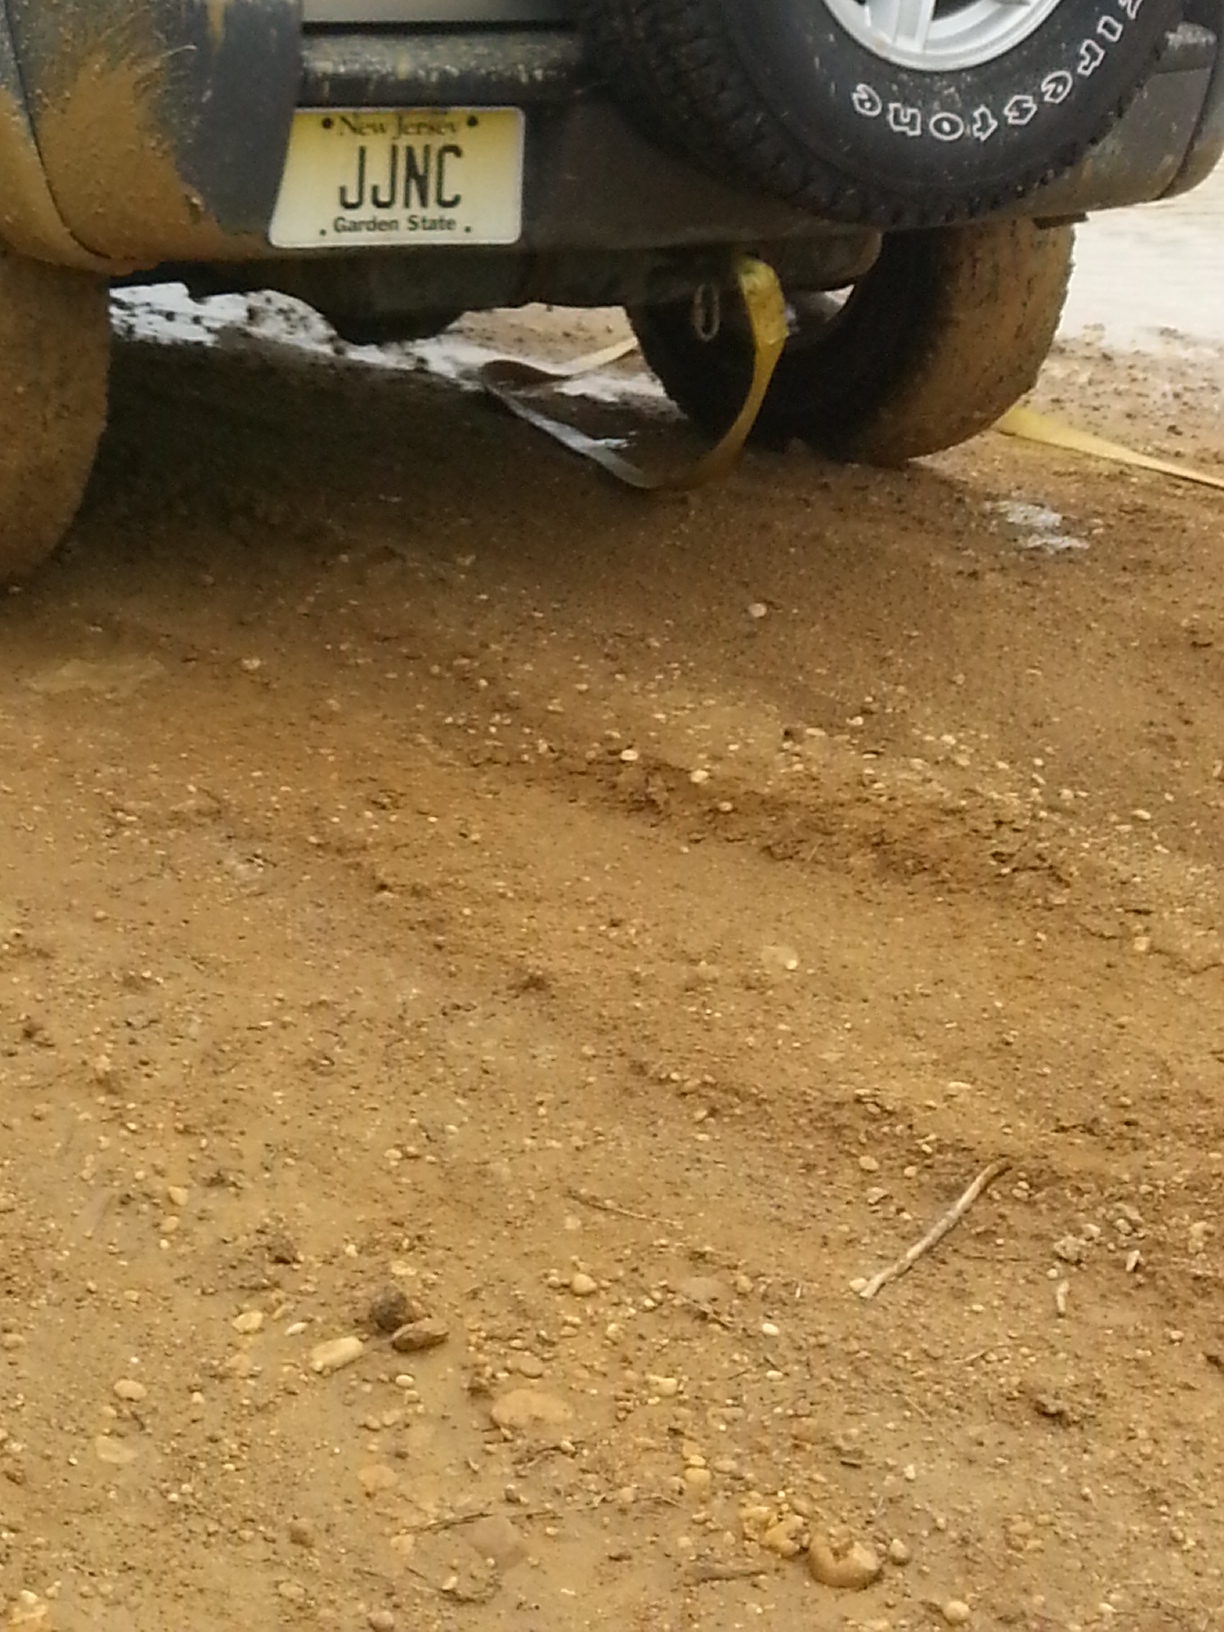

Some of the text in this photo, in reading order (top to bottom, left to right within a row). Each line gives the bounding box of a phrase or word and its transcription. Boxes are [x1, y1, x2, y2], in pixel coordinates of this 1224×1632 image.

[338, 114, 459, 141] New Jersey
[339, 143, 463, 210] JJNC
[333, 214, 457, 234] Garden State
